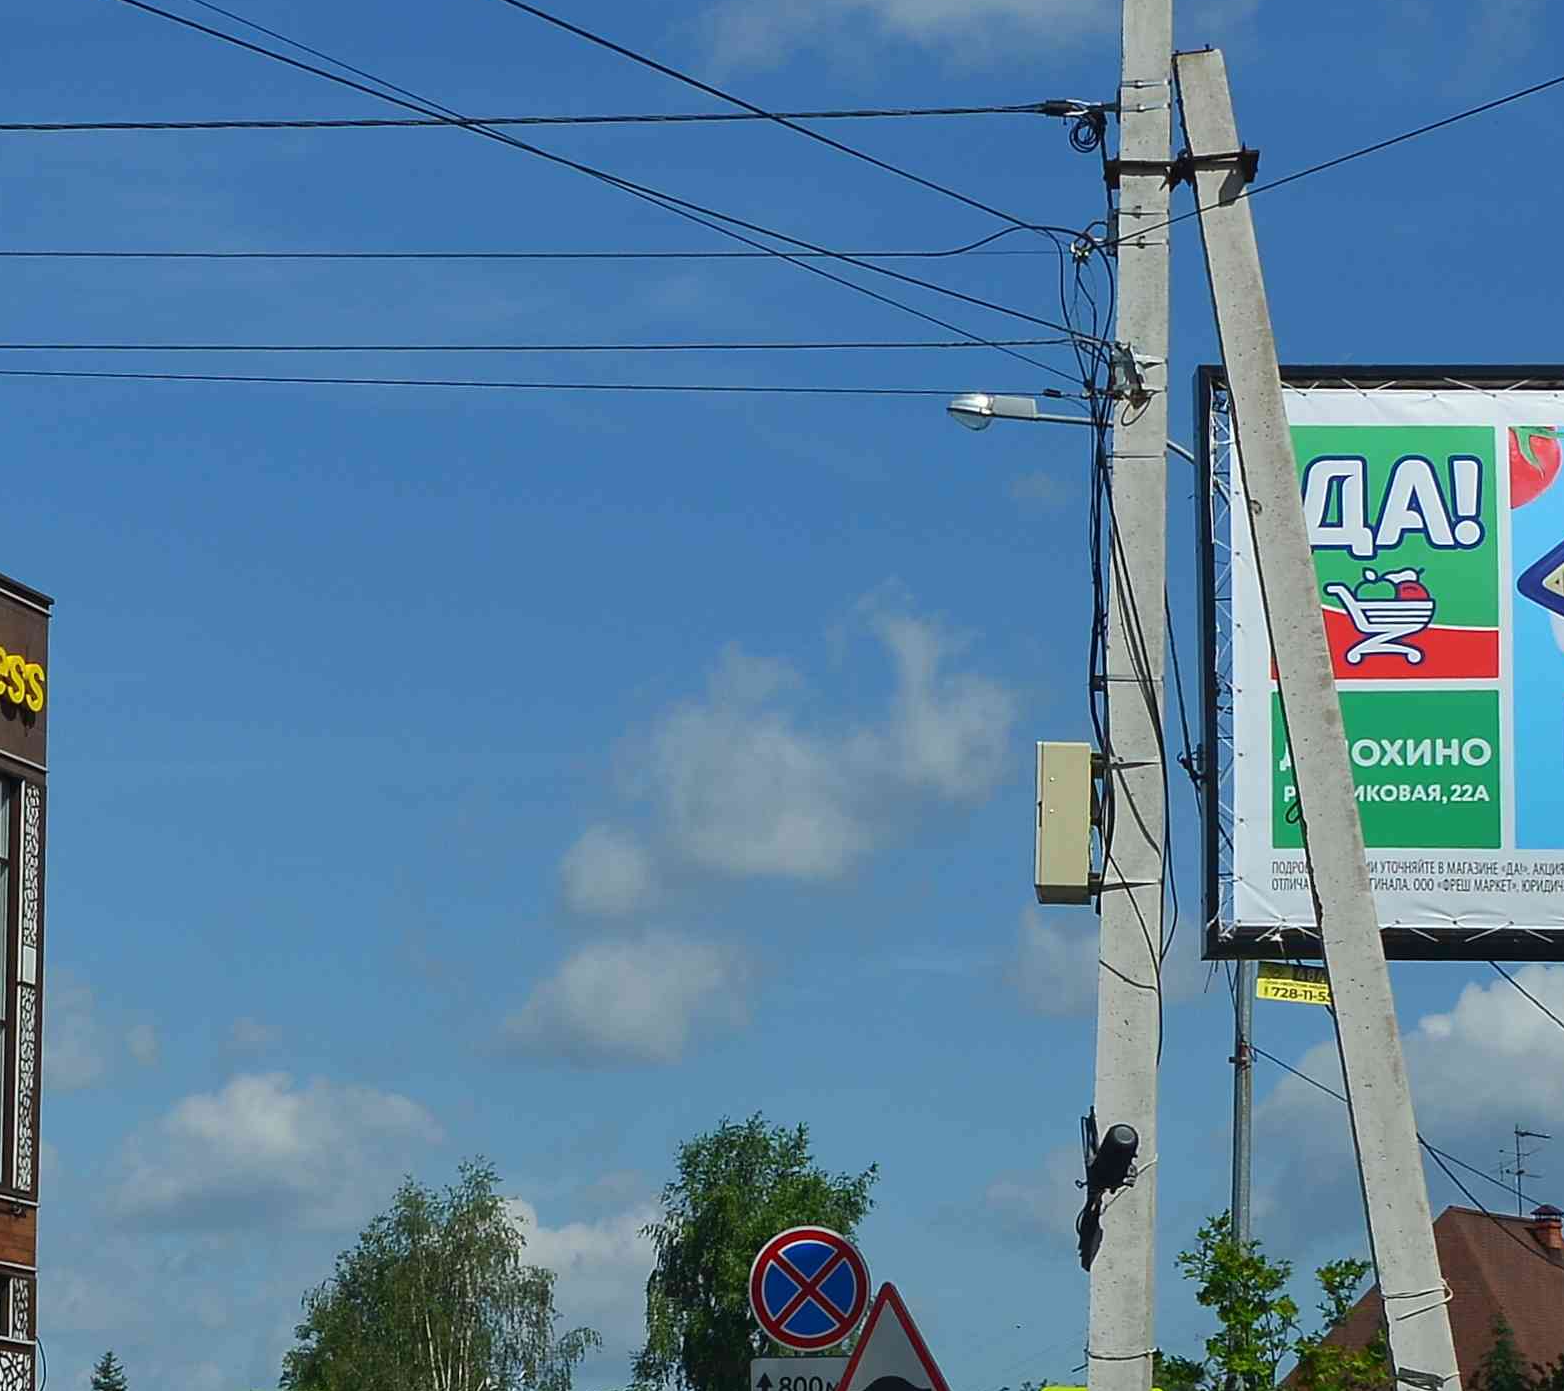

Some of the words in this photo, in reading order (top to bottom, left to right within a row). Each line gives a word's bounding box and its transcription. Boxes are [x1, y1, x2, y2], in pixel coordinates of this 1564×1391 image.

[1303, 457, 1482, 559] ДА!
[1345, 737, 1492, 767] ОХИНО
[1380, 859, 1435, 874] УТОЧНЯЙТЕ
[1438, 862, 1444, 874] В
[1447, 862, 1498, 875] МАГАЗИНЕ
[1533, 863, 1564, 876] АКЦИЯ
[1413, 878, 1435, 891] ООО
